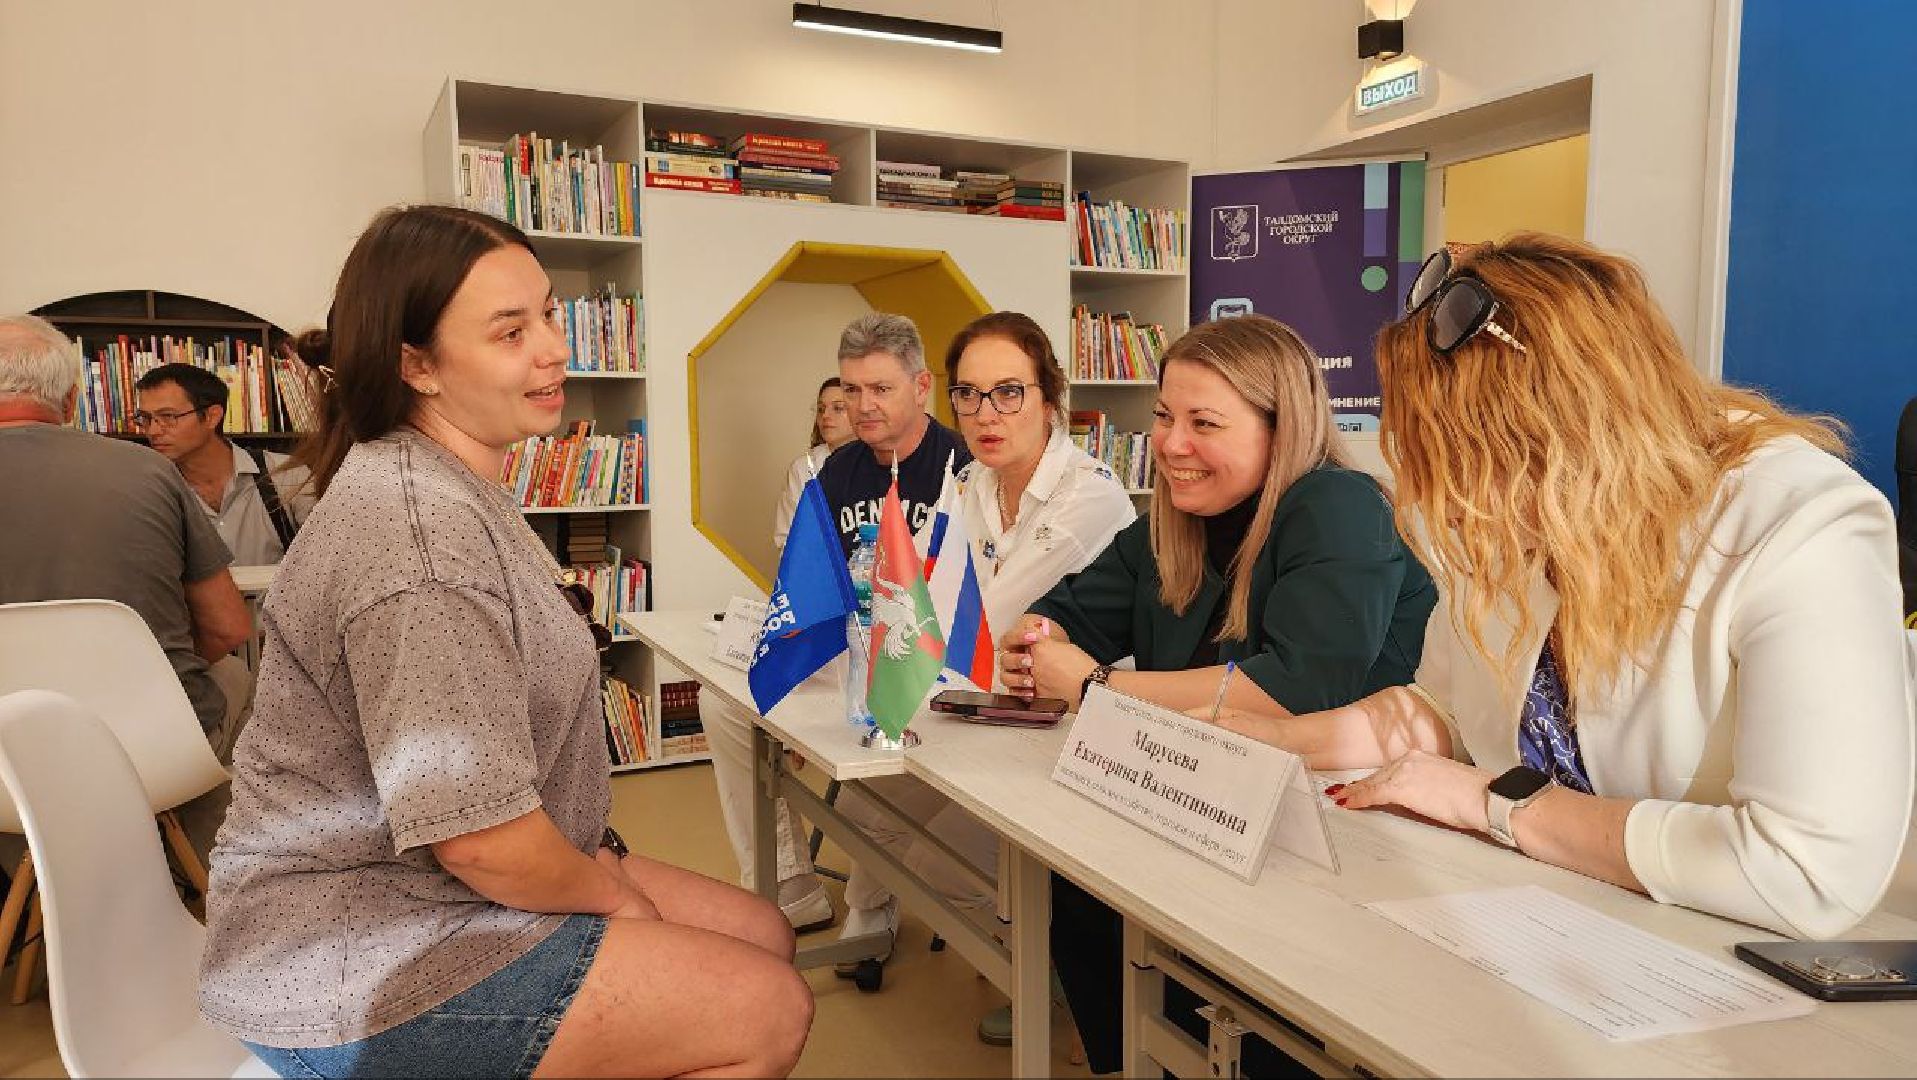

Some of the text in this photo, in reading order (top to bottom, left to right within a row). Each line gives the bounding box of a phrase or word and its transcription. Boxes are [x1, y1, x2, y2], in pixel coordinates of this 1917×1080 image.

[1363, 74, 1417, 106] ВЫХОД
[1263, 210, 1339, 225] ТАЛДОМСКИЙ
[1270, 221, 1333, 236] ГОРОДСКОЙ
[1283, 234, 1318, 245] ОКРУГ
[1132, 729, 1199, 772] Марусева
[1073, 740, 1139, 784] Екатерина
[1140, 770, 1247, 835] Валентиновна
